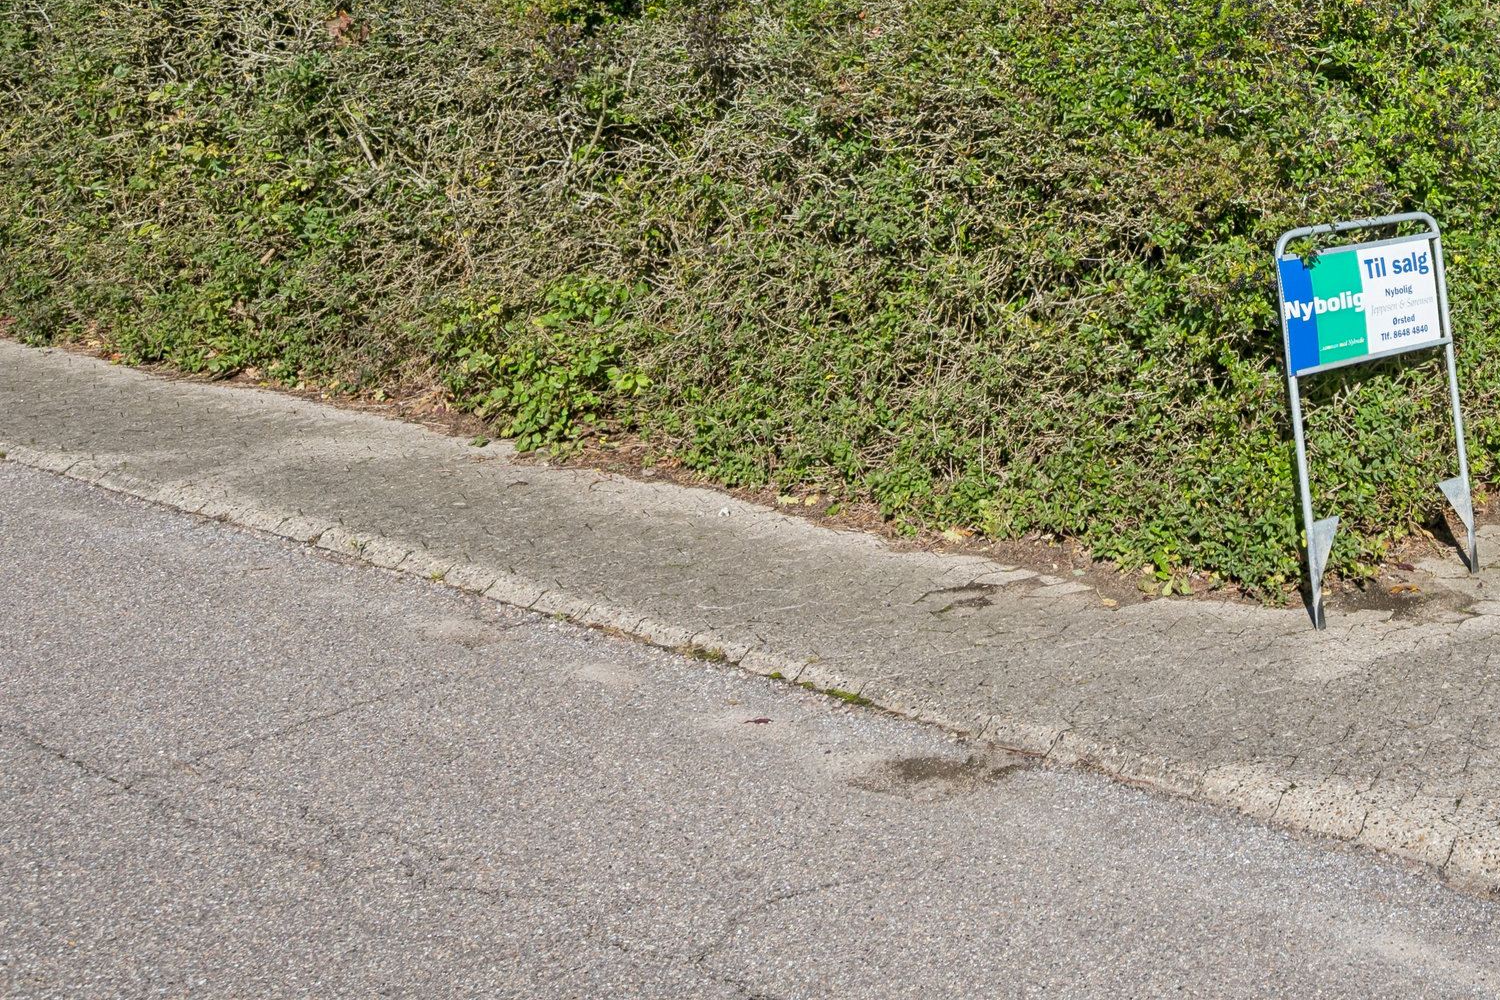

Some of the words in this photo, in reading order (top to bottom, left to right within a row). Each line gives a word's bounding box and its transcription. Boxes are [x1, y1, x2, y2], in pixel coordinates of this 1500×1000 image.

[1364, 257, 1386, 279] Til
[1392, 251, 1429, 275] salg
[1385, 284, 1413, 298] Nybolig
[1284, 291, 1366, 322] Nybolig
[1392, 314, 1416, 326] Ørsted
[1381, 332, 1392, 341] Tlf.
[1393, 327, 1411, 339] 8648
[1412, 324, 1429, 335] 4840
